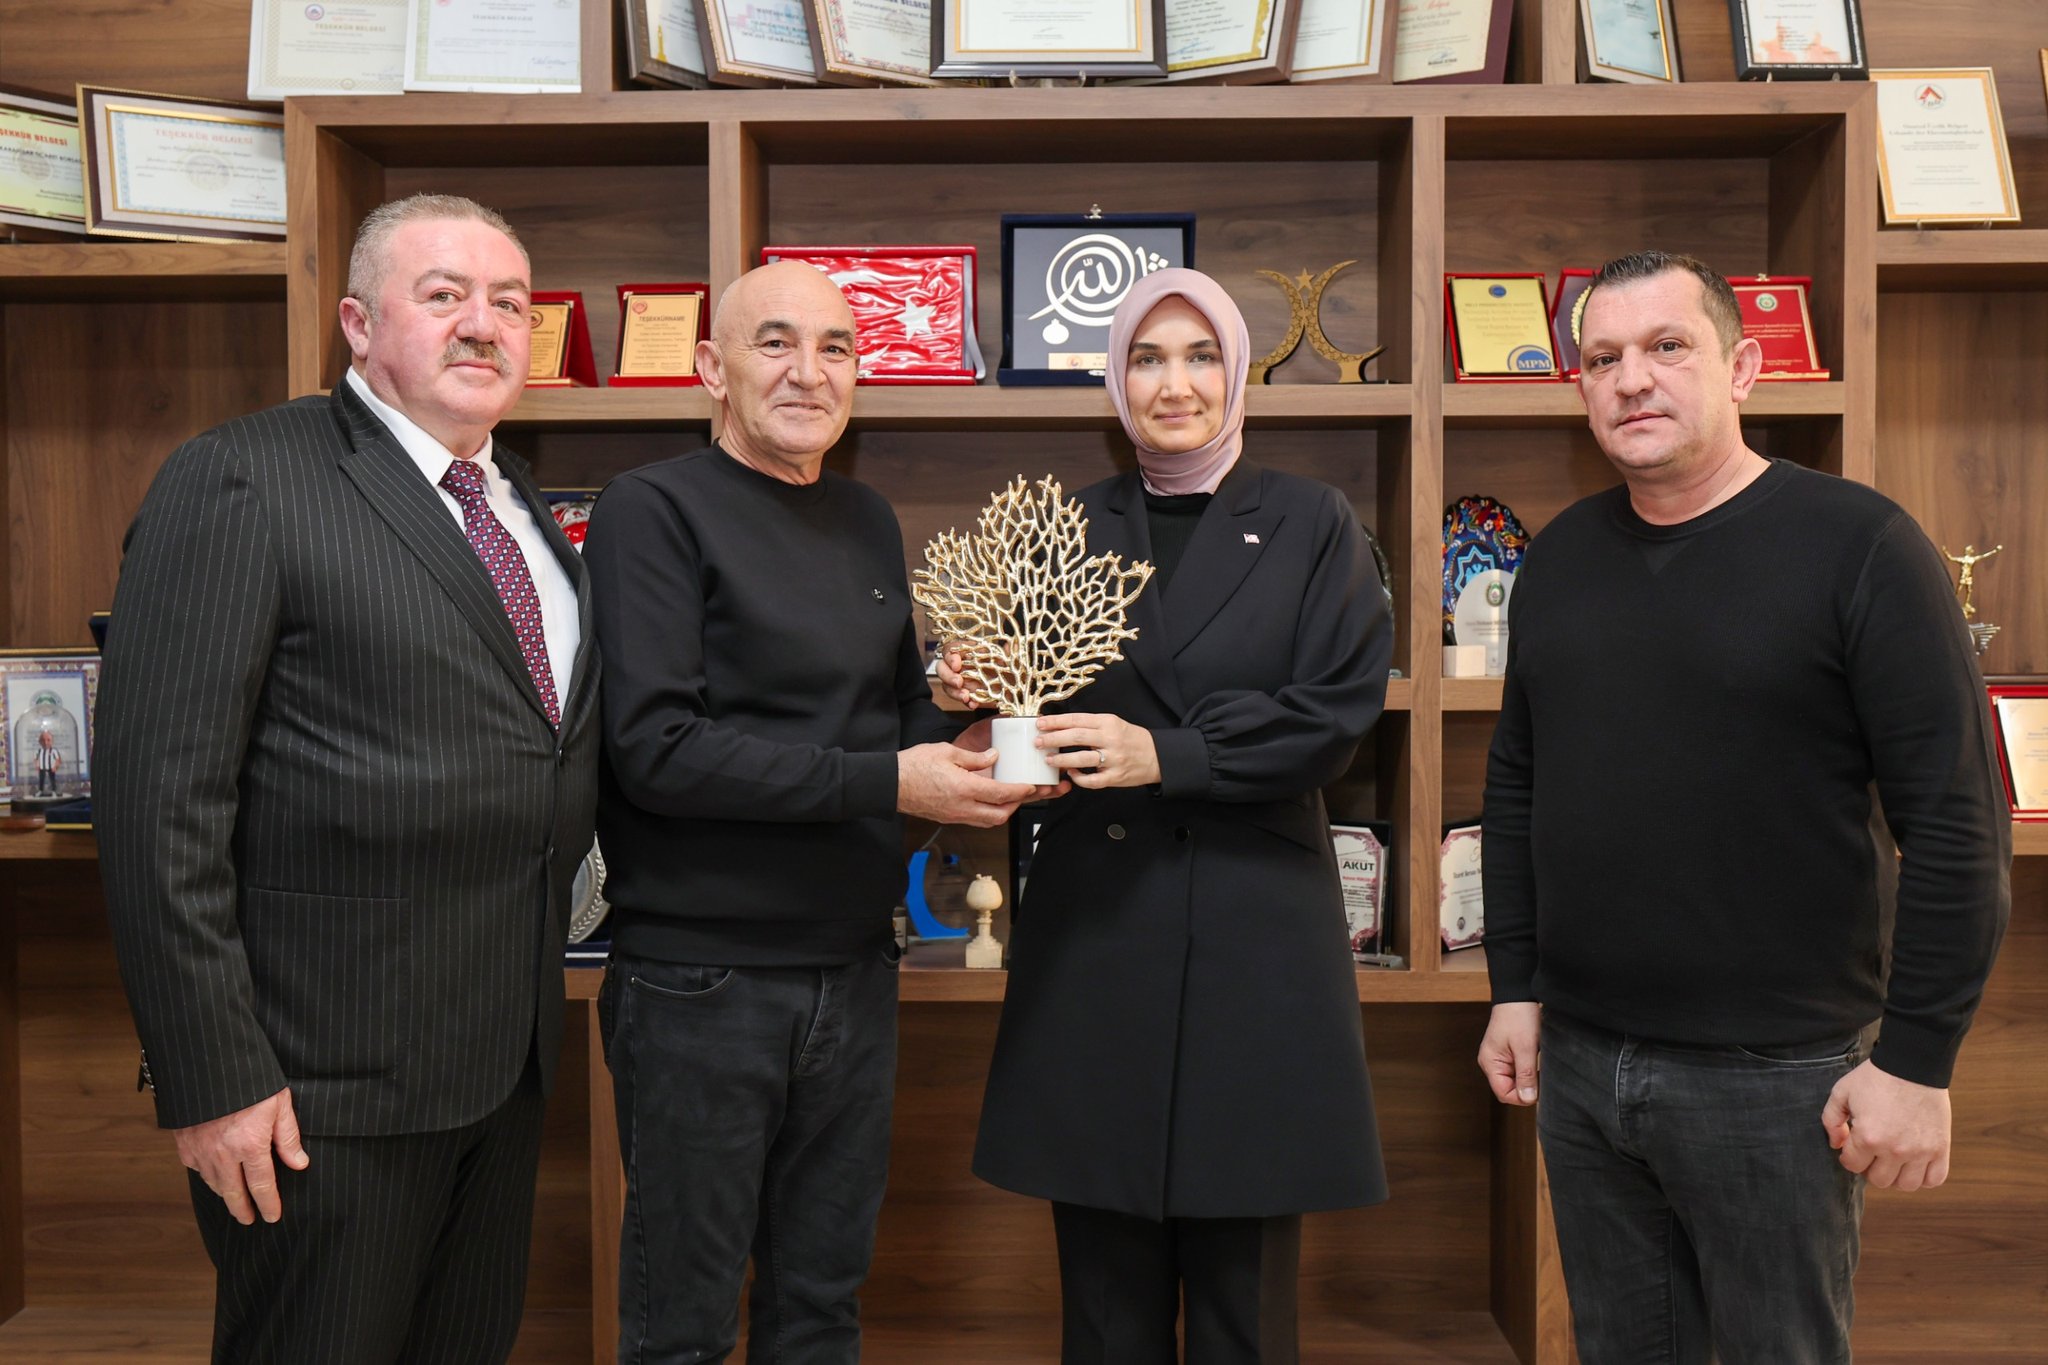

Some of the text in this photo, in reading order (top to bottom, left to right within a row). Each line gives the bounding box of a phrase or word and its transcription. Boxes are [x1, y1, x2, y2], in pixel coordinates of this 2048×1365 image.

[155, 128, 254, 145] TEŞEKKÜR BELGESİ
[1518, 359, 1550, 369] MPM
[1343, 860, 1375, 871] AKUT
